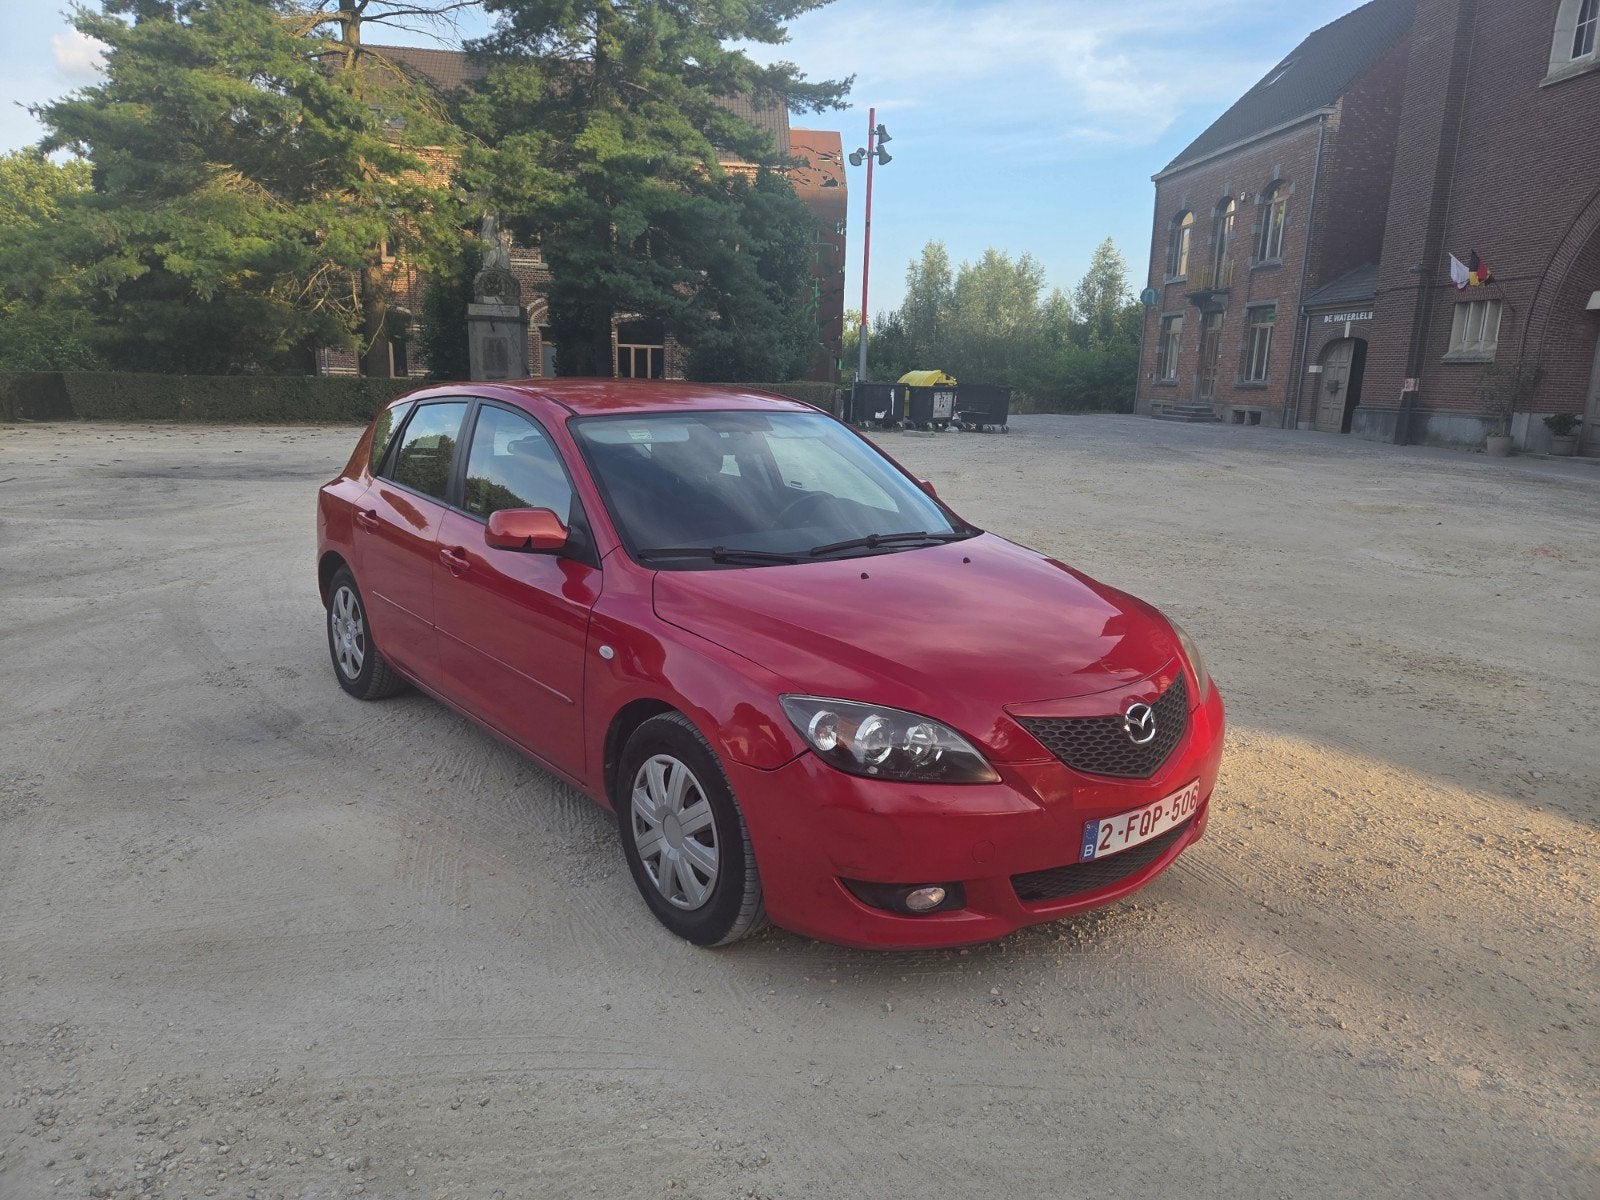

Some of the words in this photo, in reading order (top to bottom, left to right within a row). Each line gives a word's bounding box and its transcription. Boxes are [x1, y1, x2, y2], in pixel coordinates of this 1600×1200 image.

[1324, 315, 1333, 323] DE
[1098, 787, 1197, 851] 2-FQP-506
[1083, 844, 1094, 857] B
